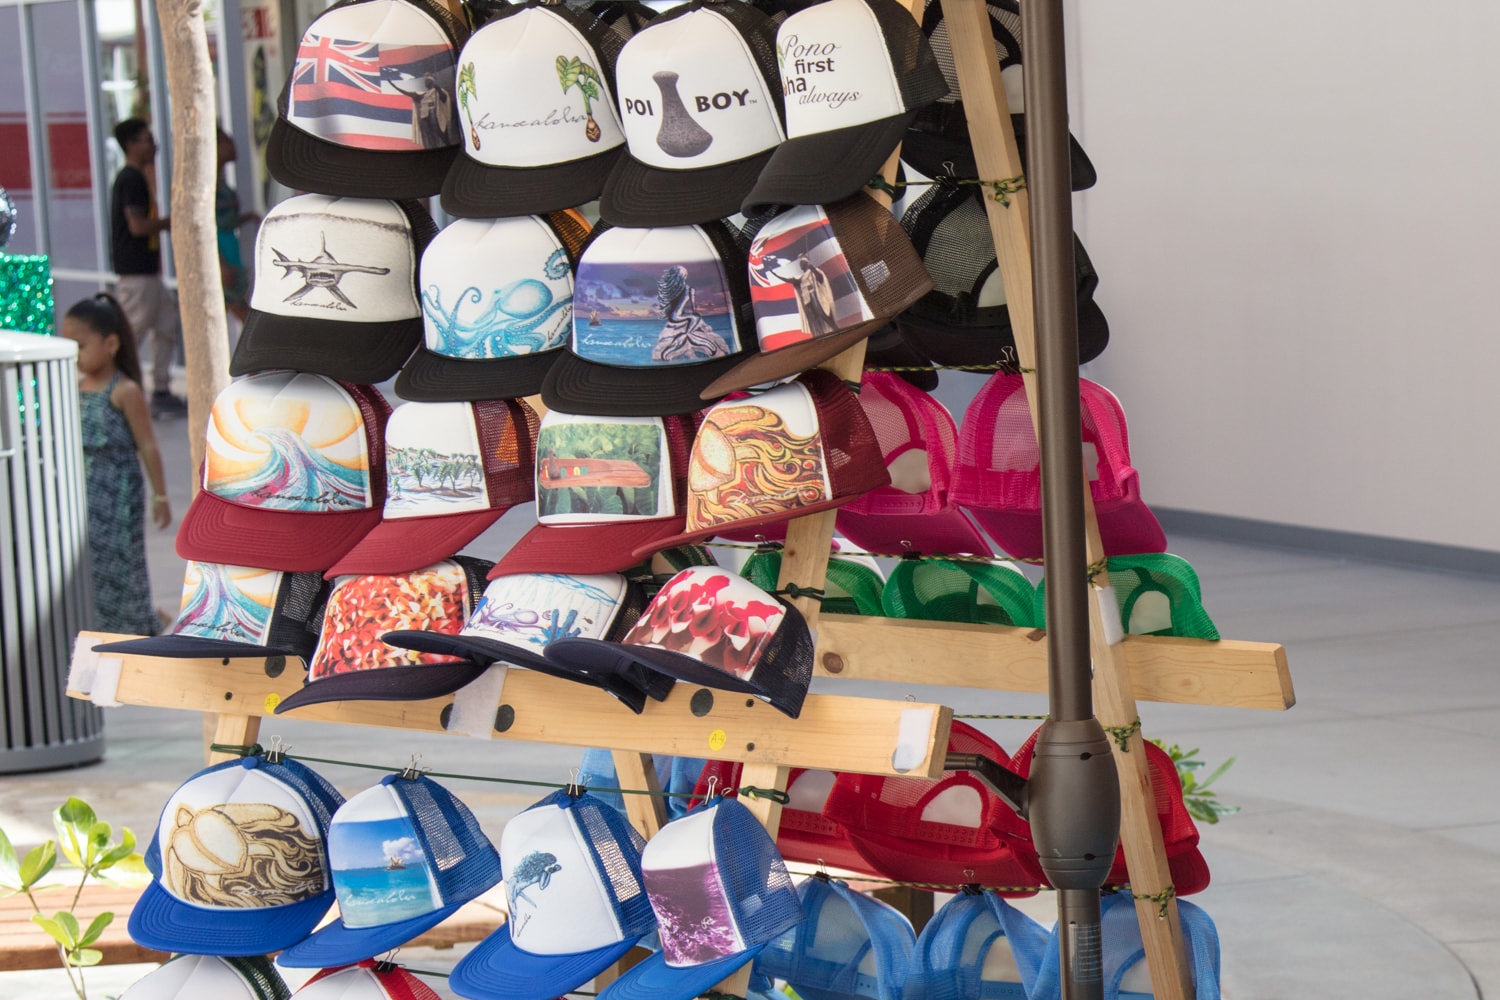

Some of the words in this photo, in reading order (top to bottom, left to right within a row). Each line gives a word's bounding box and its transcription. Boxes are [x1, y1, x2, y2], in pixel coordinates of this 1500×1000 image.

[783, 34, 842, 60] Pono
[795, 57, 835, 75] first
[625, 97, 654, 116] POI
[695, 88, 749, 112] BOY
[799, 85, 863, 109] always
